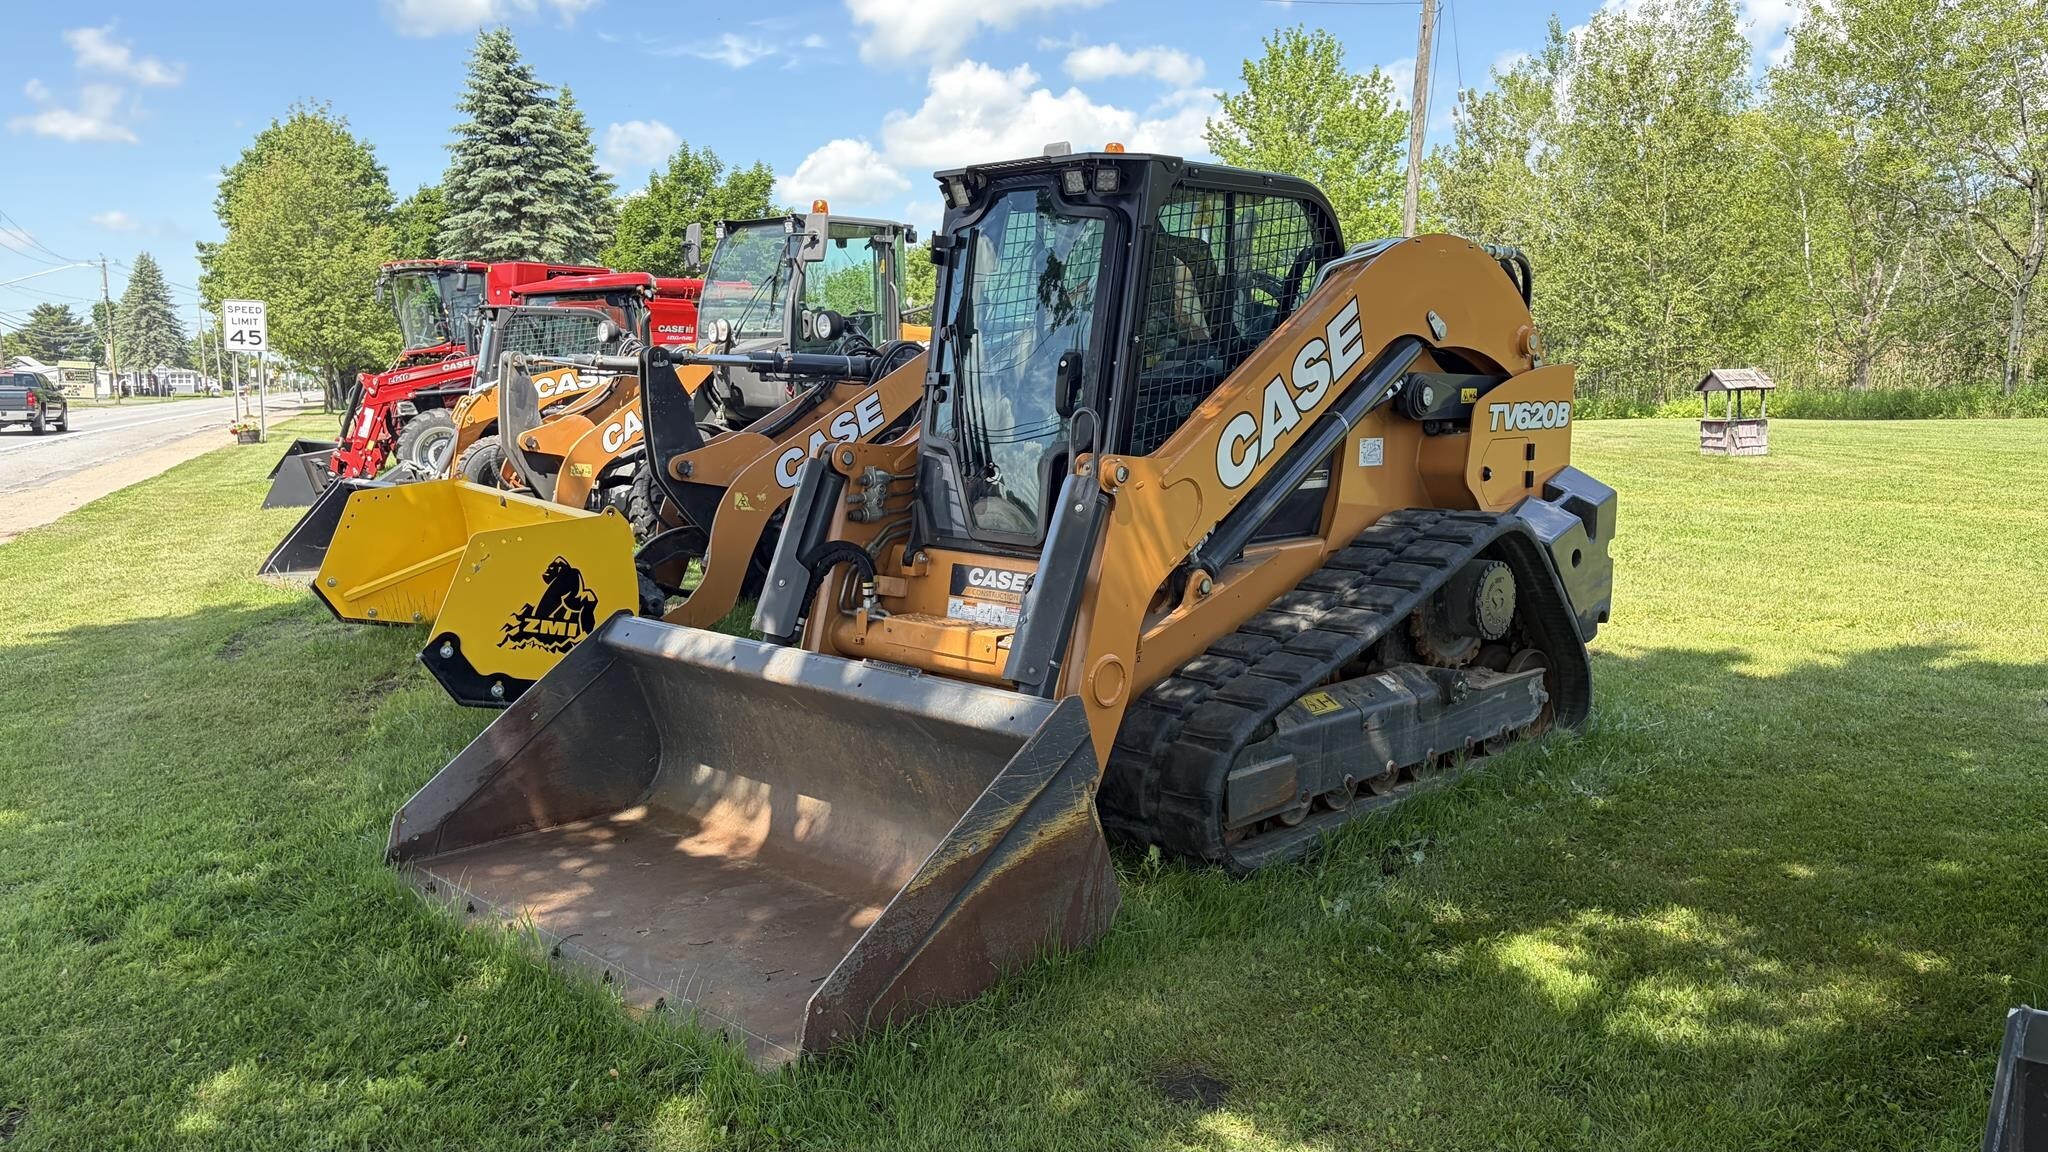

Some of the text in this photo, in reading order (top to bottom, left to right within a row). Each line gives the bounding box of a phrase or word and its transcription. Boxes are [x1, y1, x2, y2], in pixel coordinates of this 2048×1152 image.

[227, 305, 262, 314] SPEED
[231, 317, 259, 326] LIMIT
[657, 324, 685, 333] CASE
[230, 329, 262, 345] 45
[442, 358, 470, 371] CASE
[1216, 294, 1365, 490] CASE
[1489, 400, 1571, 432] TV620B
[968, 567, 1028, 592] CASE
[523, 617, 578, 637] ZMI
